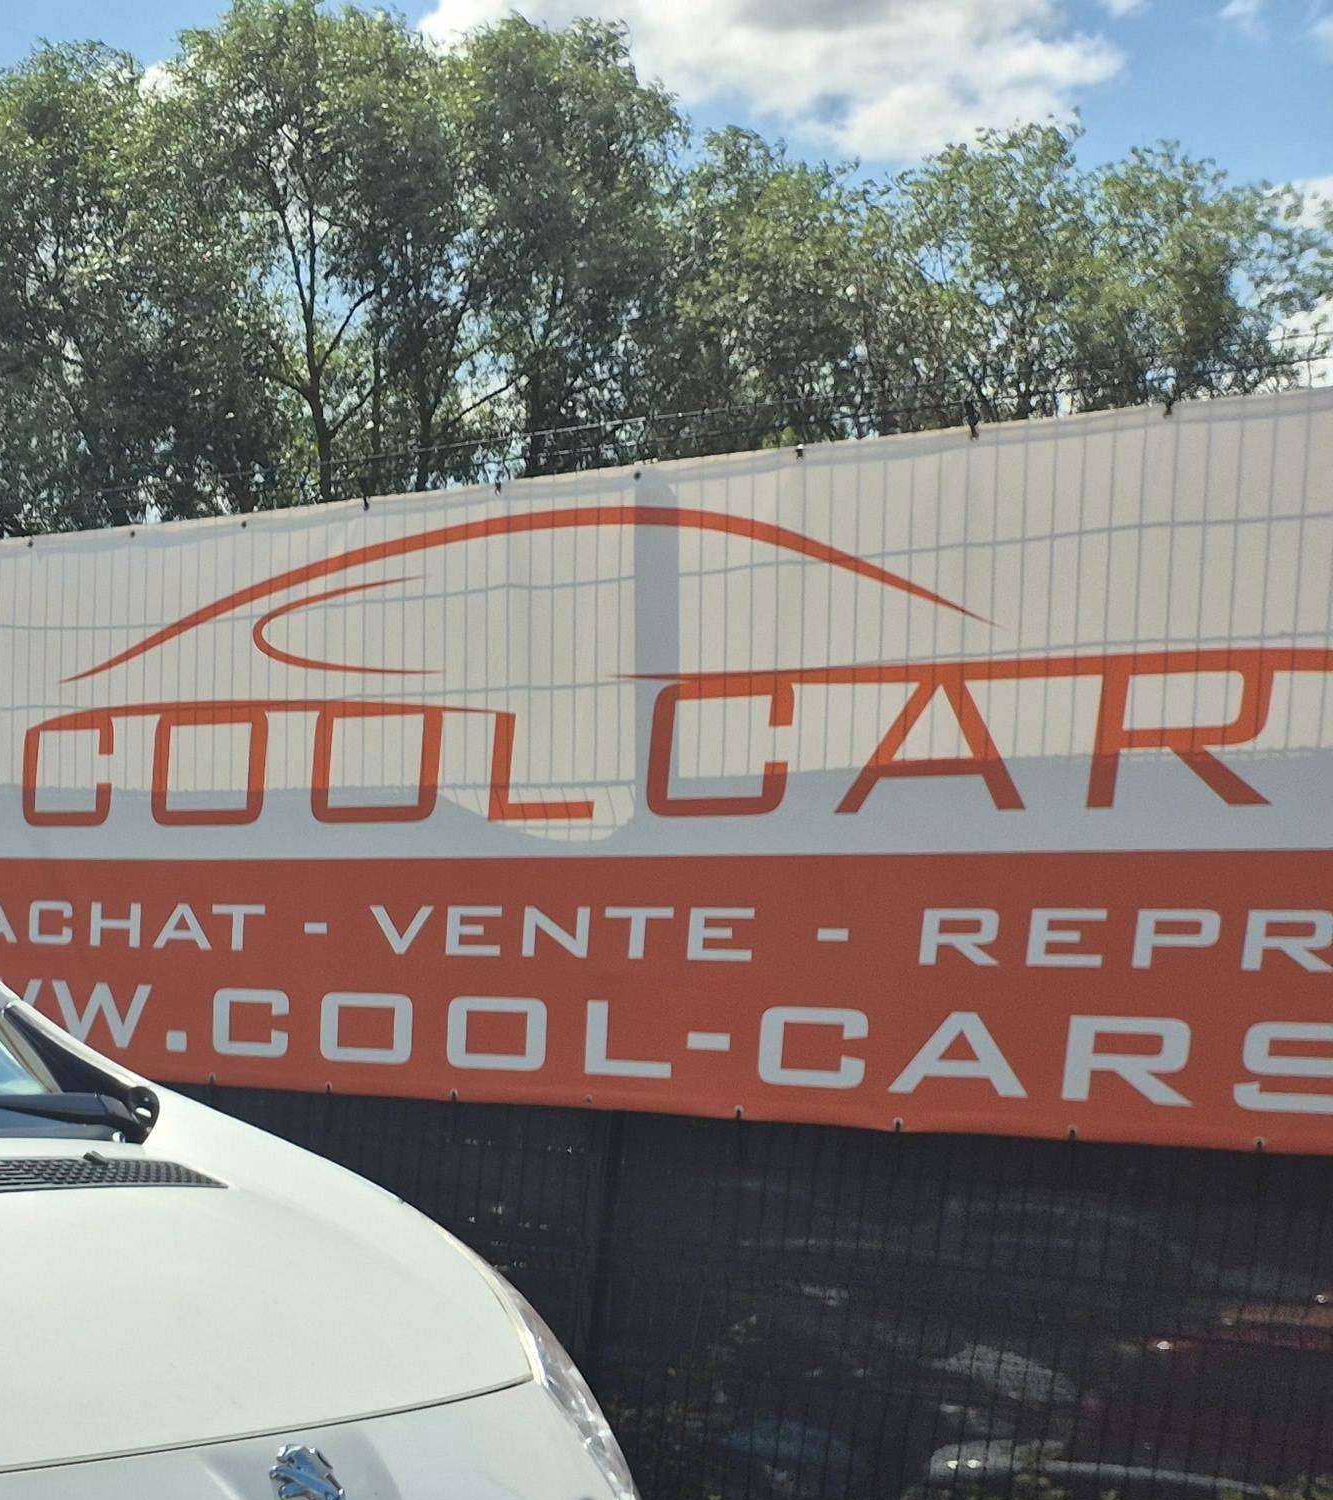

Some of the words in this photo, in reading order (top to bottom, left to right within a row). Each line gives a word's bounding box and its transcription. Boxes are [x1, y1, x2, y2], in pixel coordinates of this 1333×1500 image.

[369, 904, 756, 962] VENTE
[918, 907, 1333, 973] REPR
[0, 977, 1333, 1116] W.COOL-CARS
